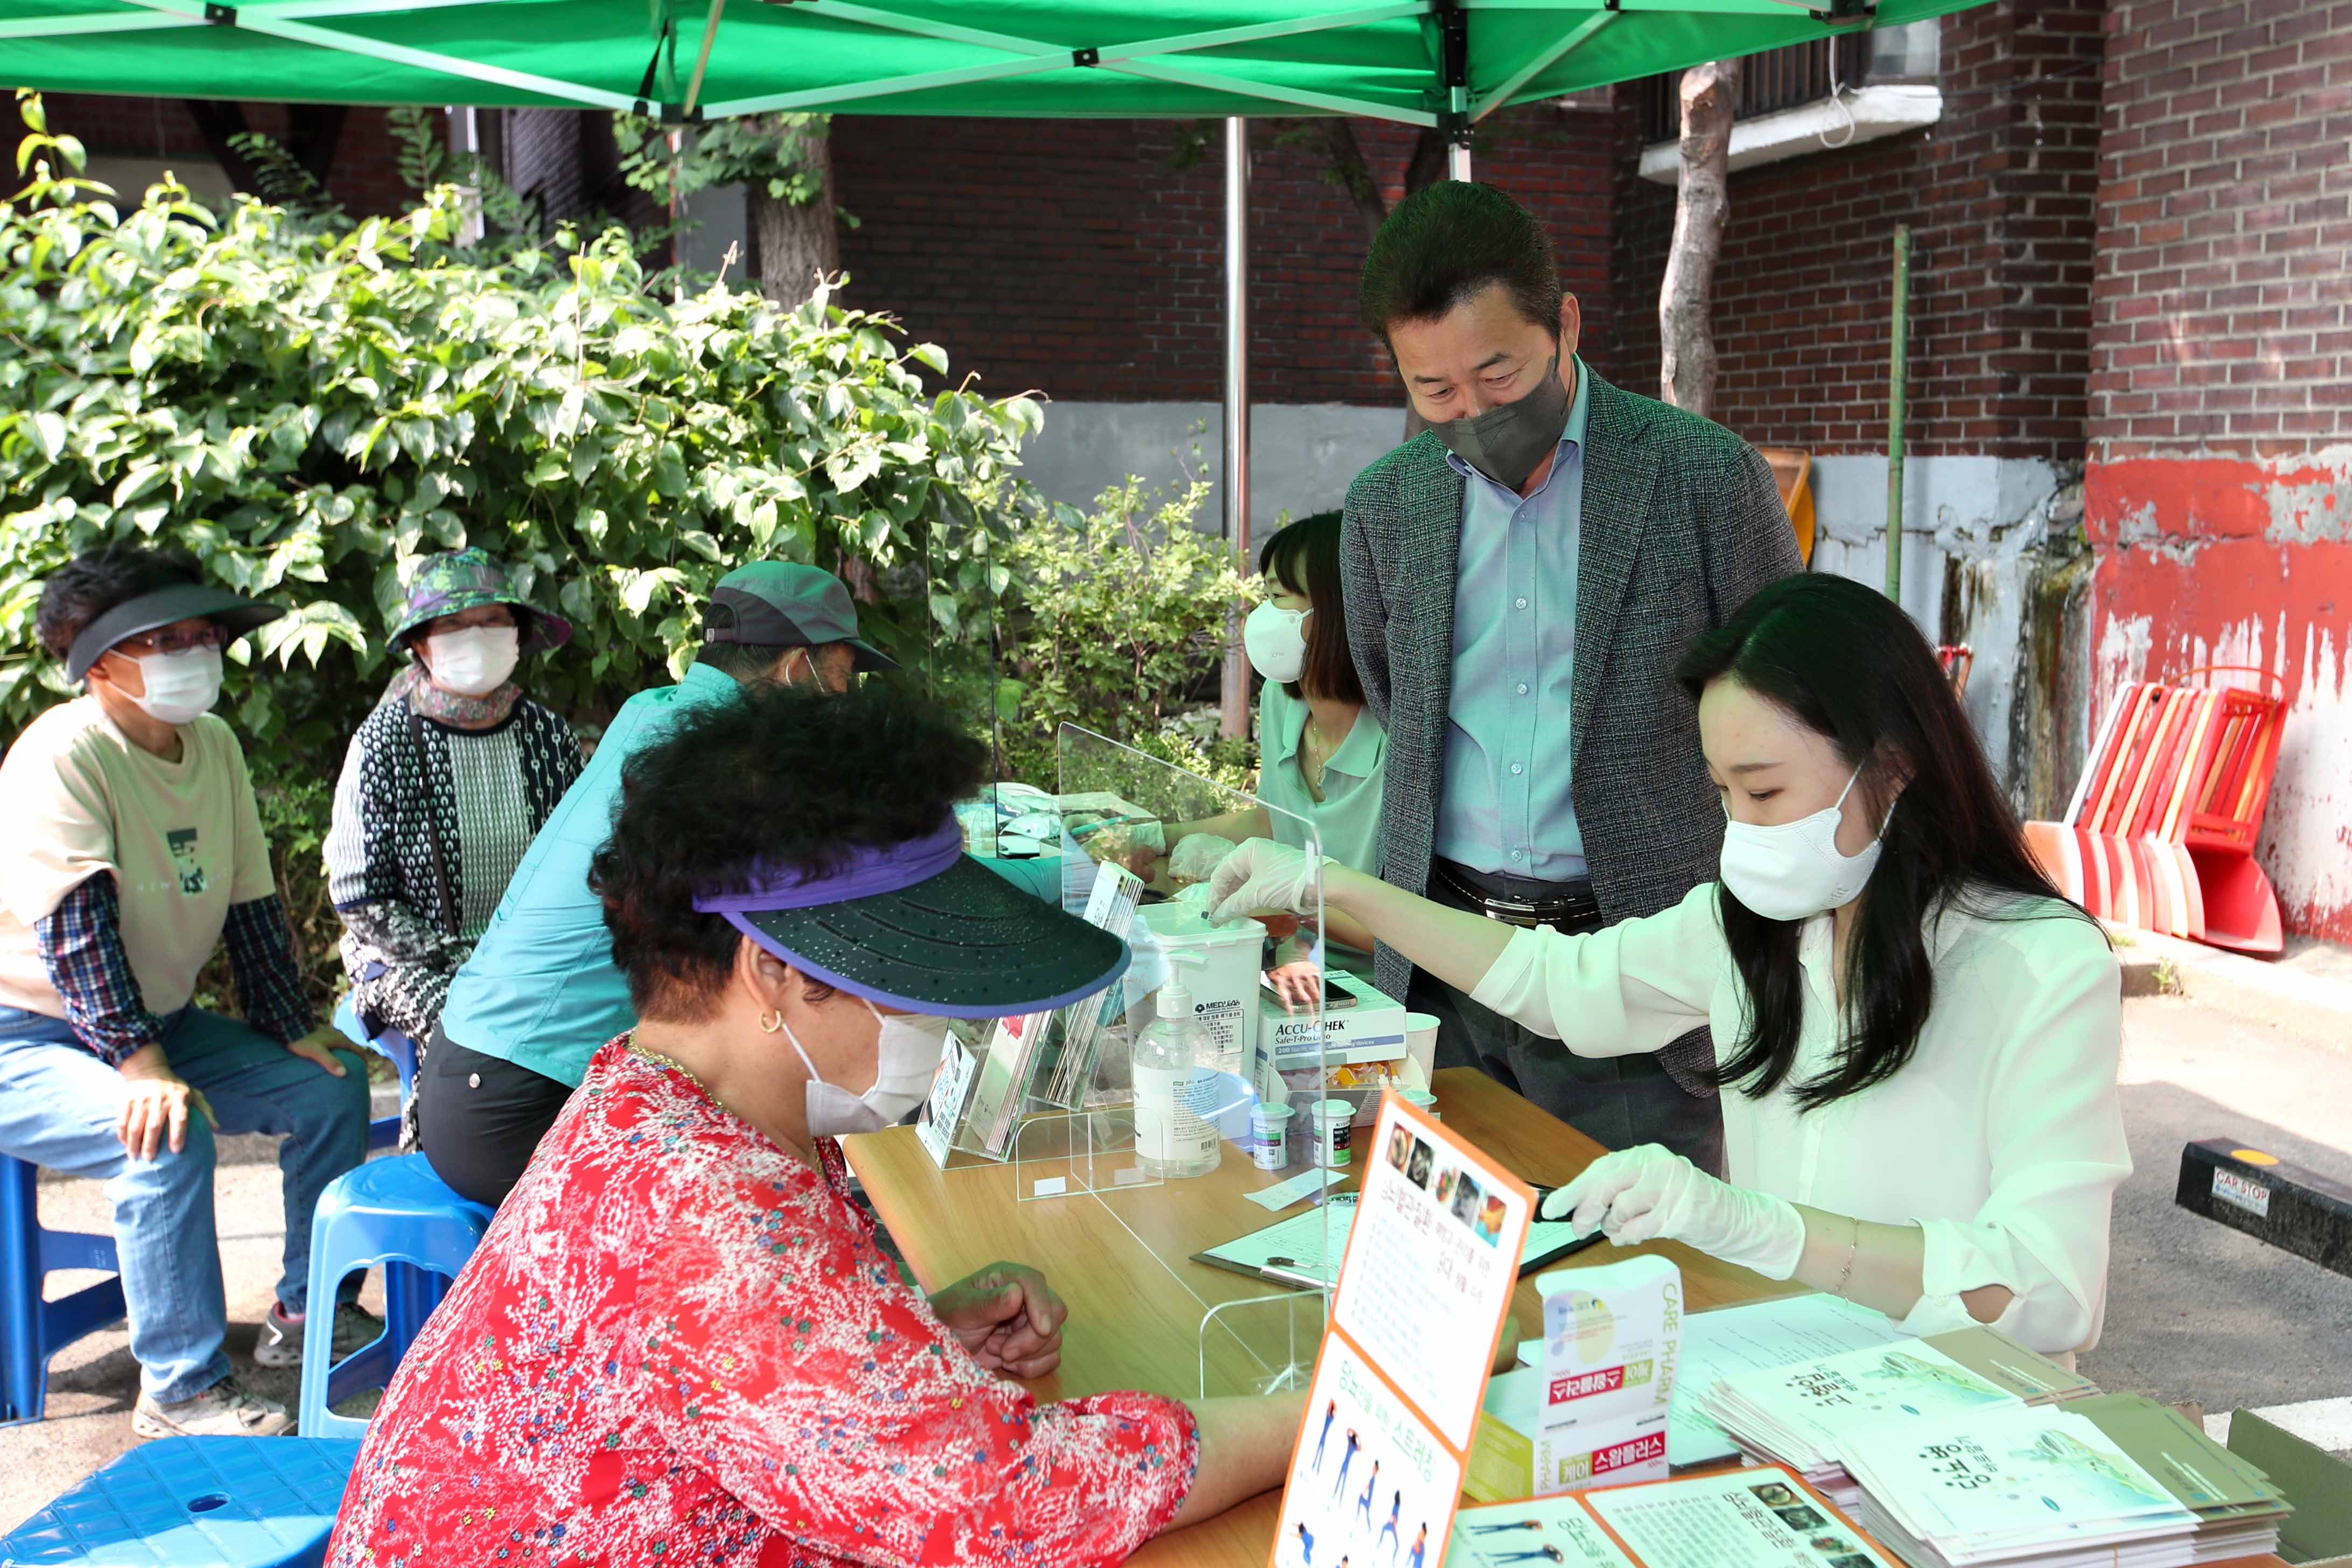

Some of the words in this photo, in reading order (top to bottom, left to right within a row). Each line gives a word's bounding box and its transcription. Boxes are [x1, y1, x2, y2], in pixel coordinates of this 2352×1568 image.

[1276, 1034, 1312, 1045] Safe-T-Pro
[2216, 1171, 2237, 1187] CAR
[2241, 1181, 2267, 1200] STOP
[1662, 1283, 1678, 1333] CARE
[1654, 1339, 1677, 1406] PHARM
[1790, 1373, 1853, 1406] 고혈압
[1922, 1444, 1991, 1489] 당뇨병
